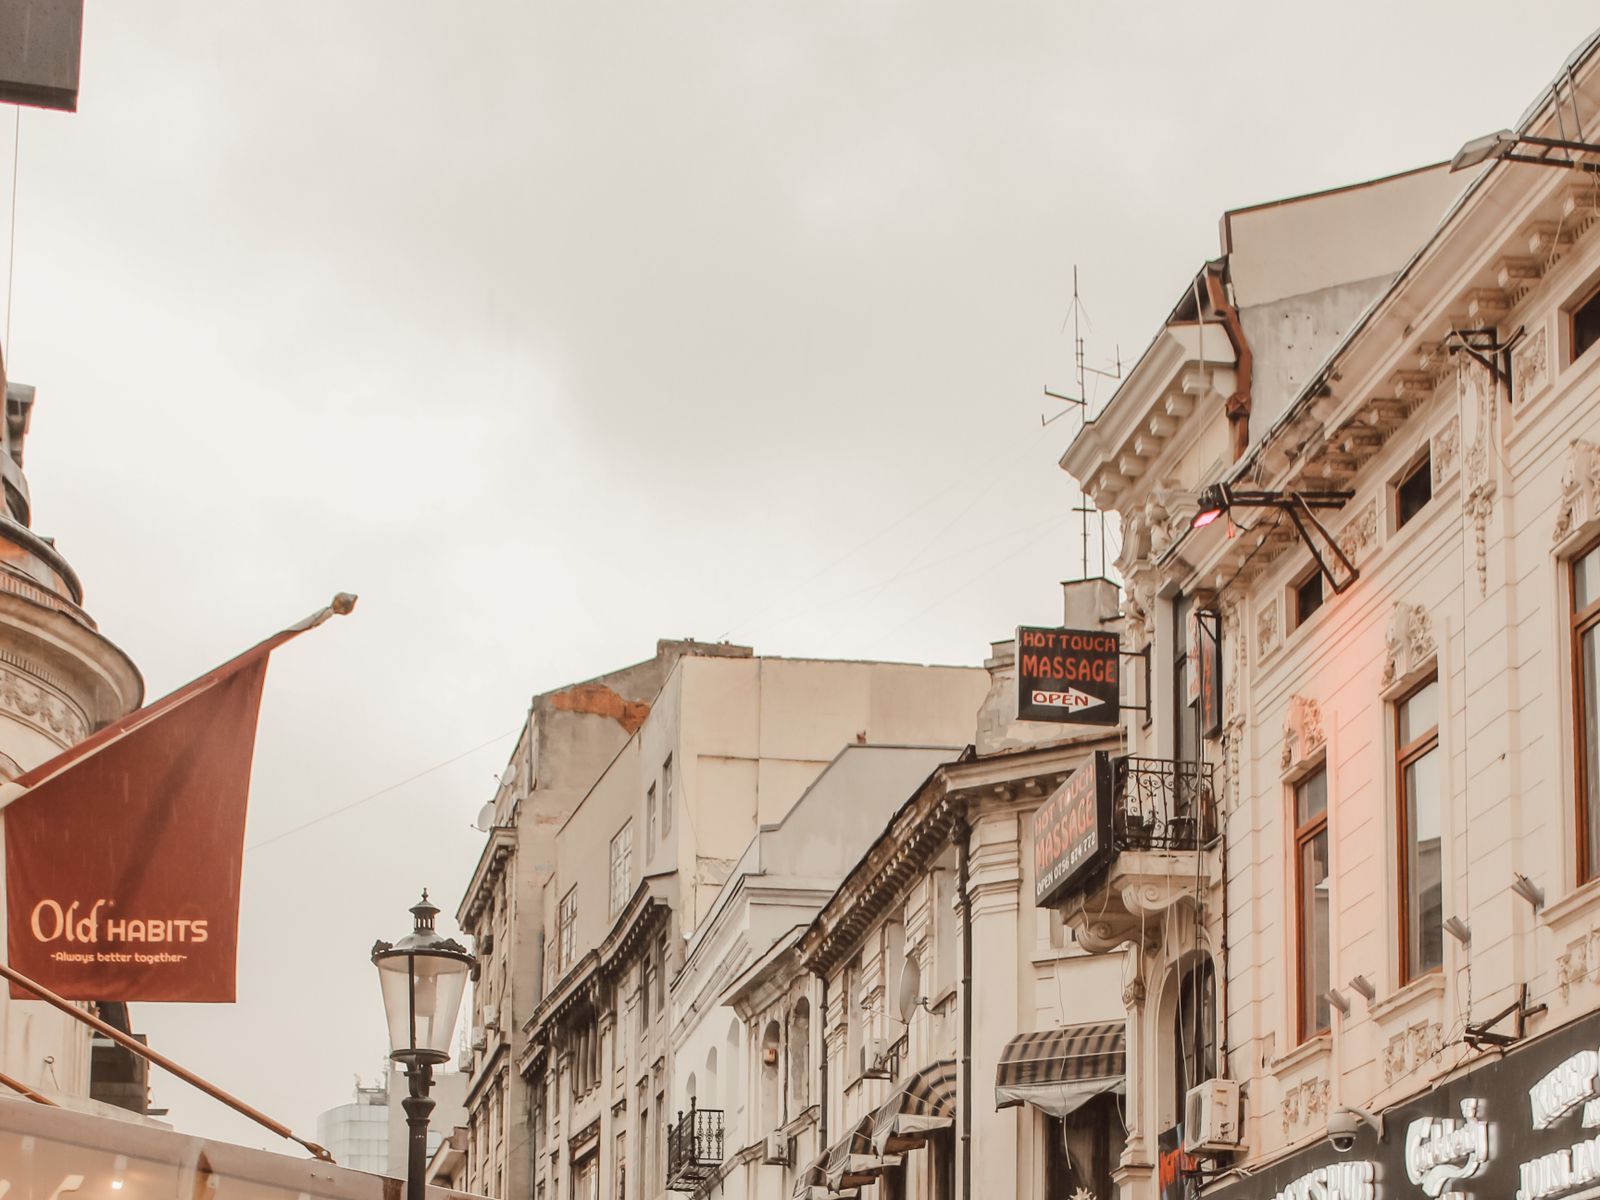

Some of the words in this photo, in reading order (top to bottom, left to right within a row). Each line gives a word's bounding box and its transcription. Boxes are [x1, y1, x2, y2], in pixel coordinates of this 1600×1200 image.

[1023, 631, 1056, 649] HOT
[1060, 634, 1116, 651] TOUCH
[1023, 655, 1117, 683] MASSAGE
[1033, 692, 1089, 707] OPEN
[1034, 803, 1056, 836] HOT
[1057, 763, 1094, 812] TOUCH
[1035, 789, 1094, 878] MASSAGE
[1036, 870, 1054, 896] OPEN
[31, 899, 106, 943] Old
[107, 919, 209, 943] HABITS
[97, 952, 132, 963] better
